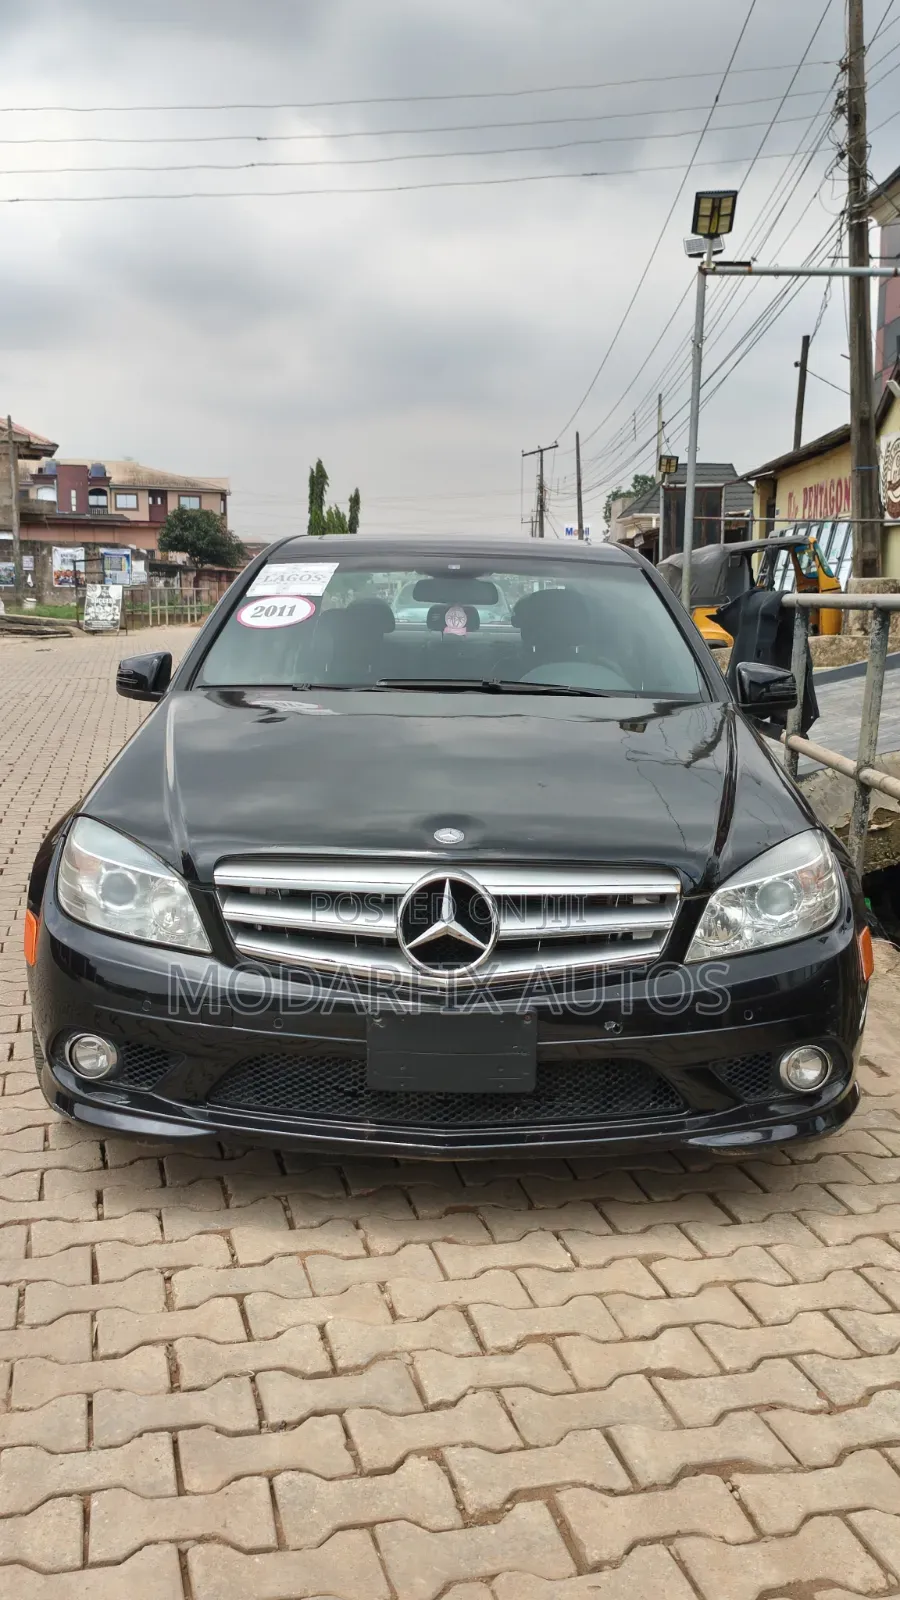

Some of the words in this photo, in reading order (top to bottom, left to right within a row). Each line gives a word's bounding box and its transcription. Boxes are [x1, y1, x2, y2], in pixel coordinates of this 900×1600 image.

[803, 476, 850, 519] PENTAGON
[565, 527, 589, 536] Moil
[263, 573, 324, 583] LAGOS
[250, 604, 297, 618] 2011
